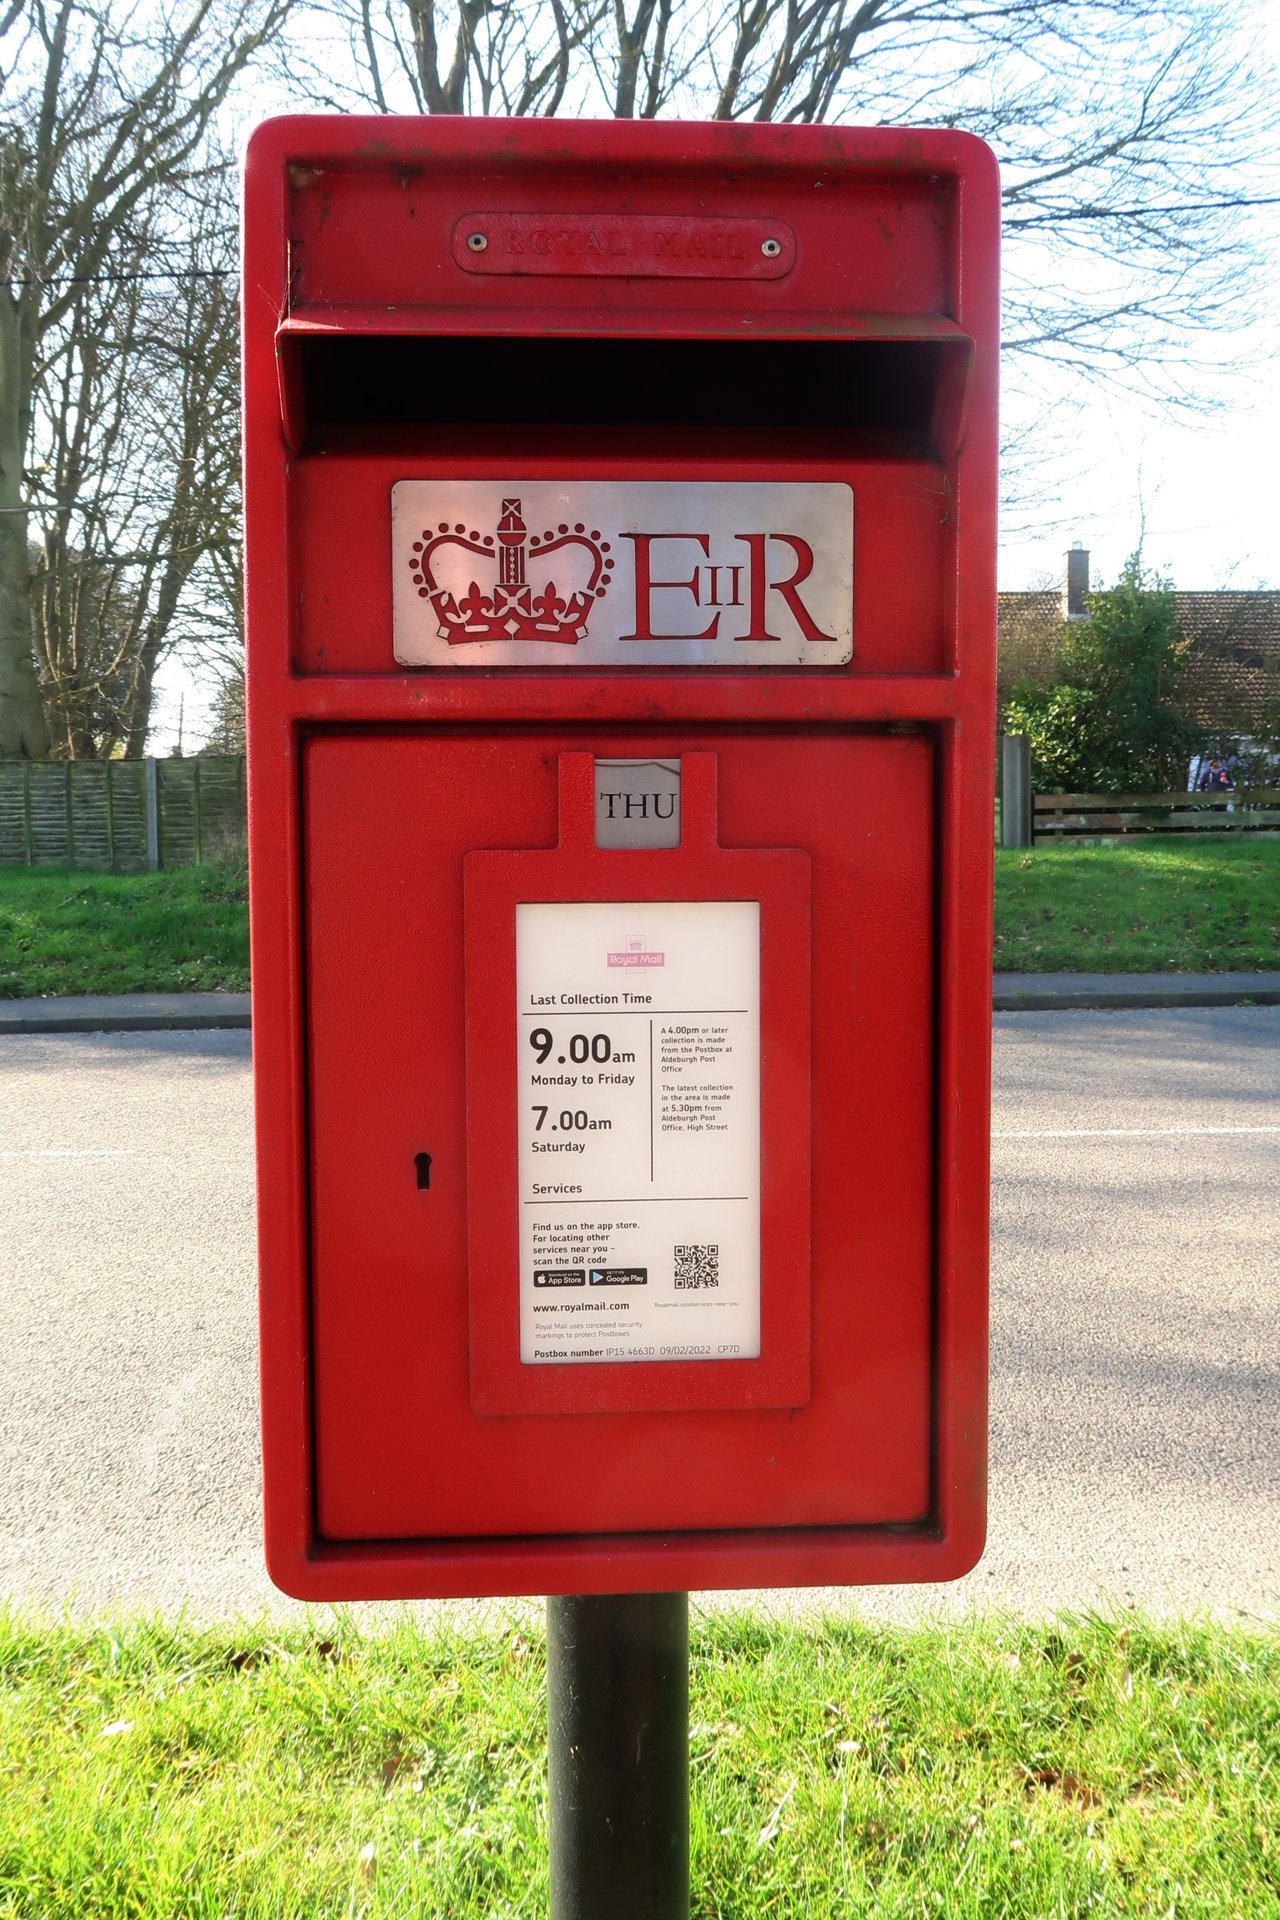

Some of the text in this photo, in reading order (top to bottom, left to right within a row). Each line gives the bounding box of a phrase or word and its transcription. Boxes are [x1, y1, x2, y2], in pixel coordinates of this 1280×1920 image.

[504, 231, 747, 260] ROYAL MAIL
[600, 792, 677, 819] THU
[610, 955, 662, 965] Royal Mail
[530, 993, 652, 1005] Last Collection Time
[668, 1026, 699, 1035] 4.00pm
[530, 1028, 636, 1064] 9.00am
[662, 1056, 698, 1064] Aldeburgh
[531, 1074, 635, 1087] Monday to Friday
[671, 1104, 702, 1113] 5.30pm
[531, 1106, 612, 1131] 7.00am
[532, 1142, 586, 1153] Saturday
[532, 1184, 582, 1194] Services
[550, 1234, 583, 1243] locating
[533, 1246, 568, 1254] services
[533, 1302, 630, 1313] www.royalmail.com
[535, 1350, 567, 1358] Postbox
[606, 1348, 625, 1356] IP15
[627, 1347, 655, 1356] 4663D
[660, 1346, 710, 1355] 09/02/2022
[718, 1345, 740, 1353] CP7D
